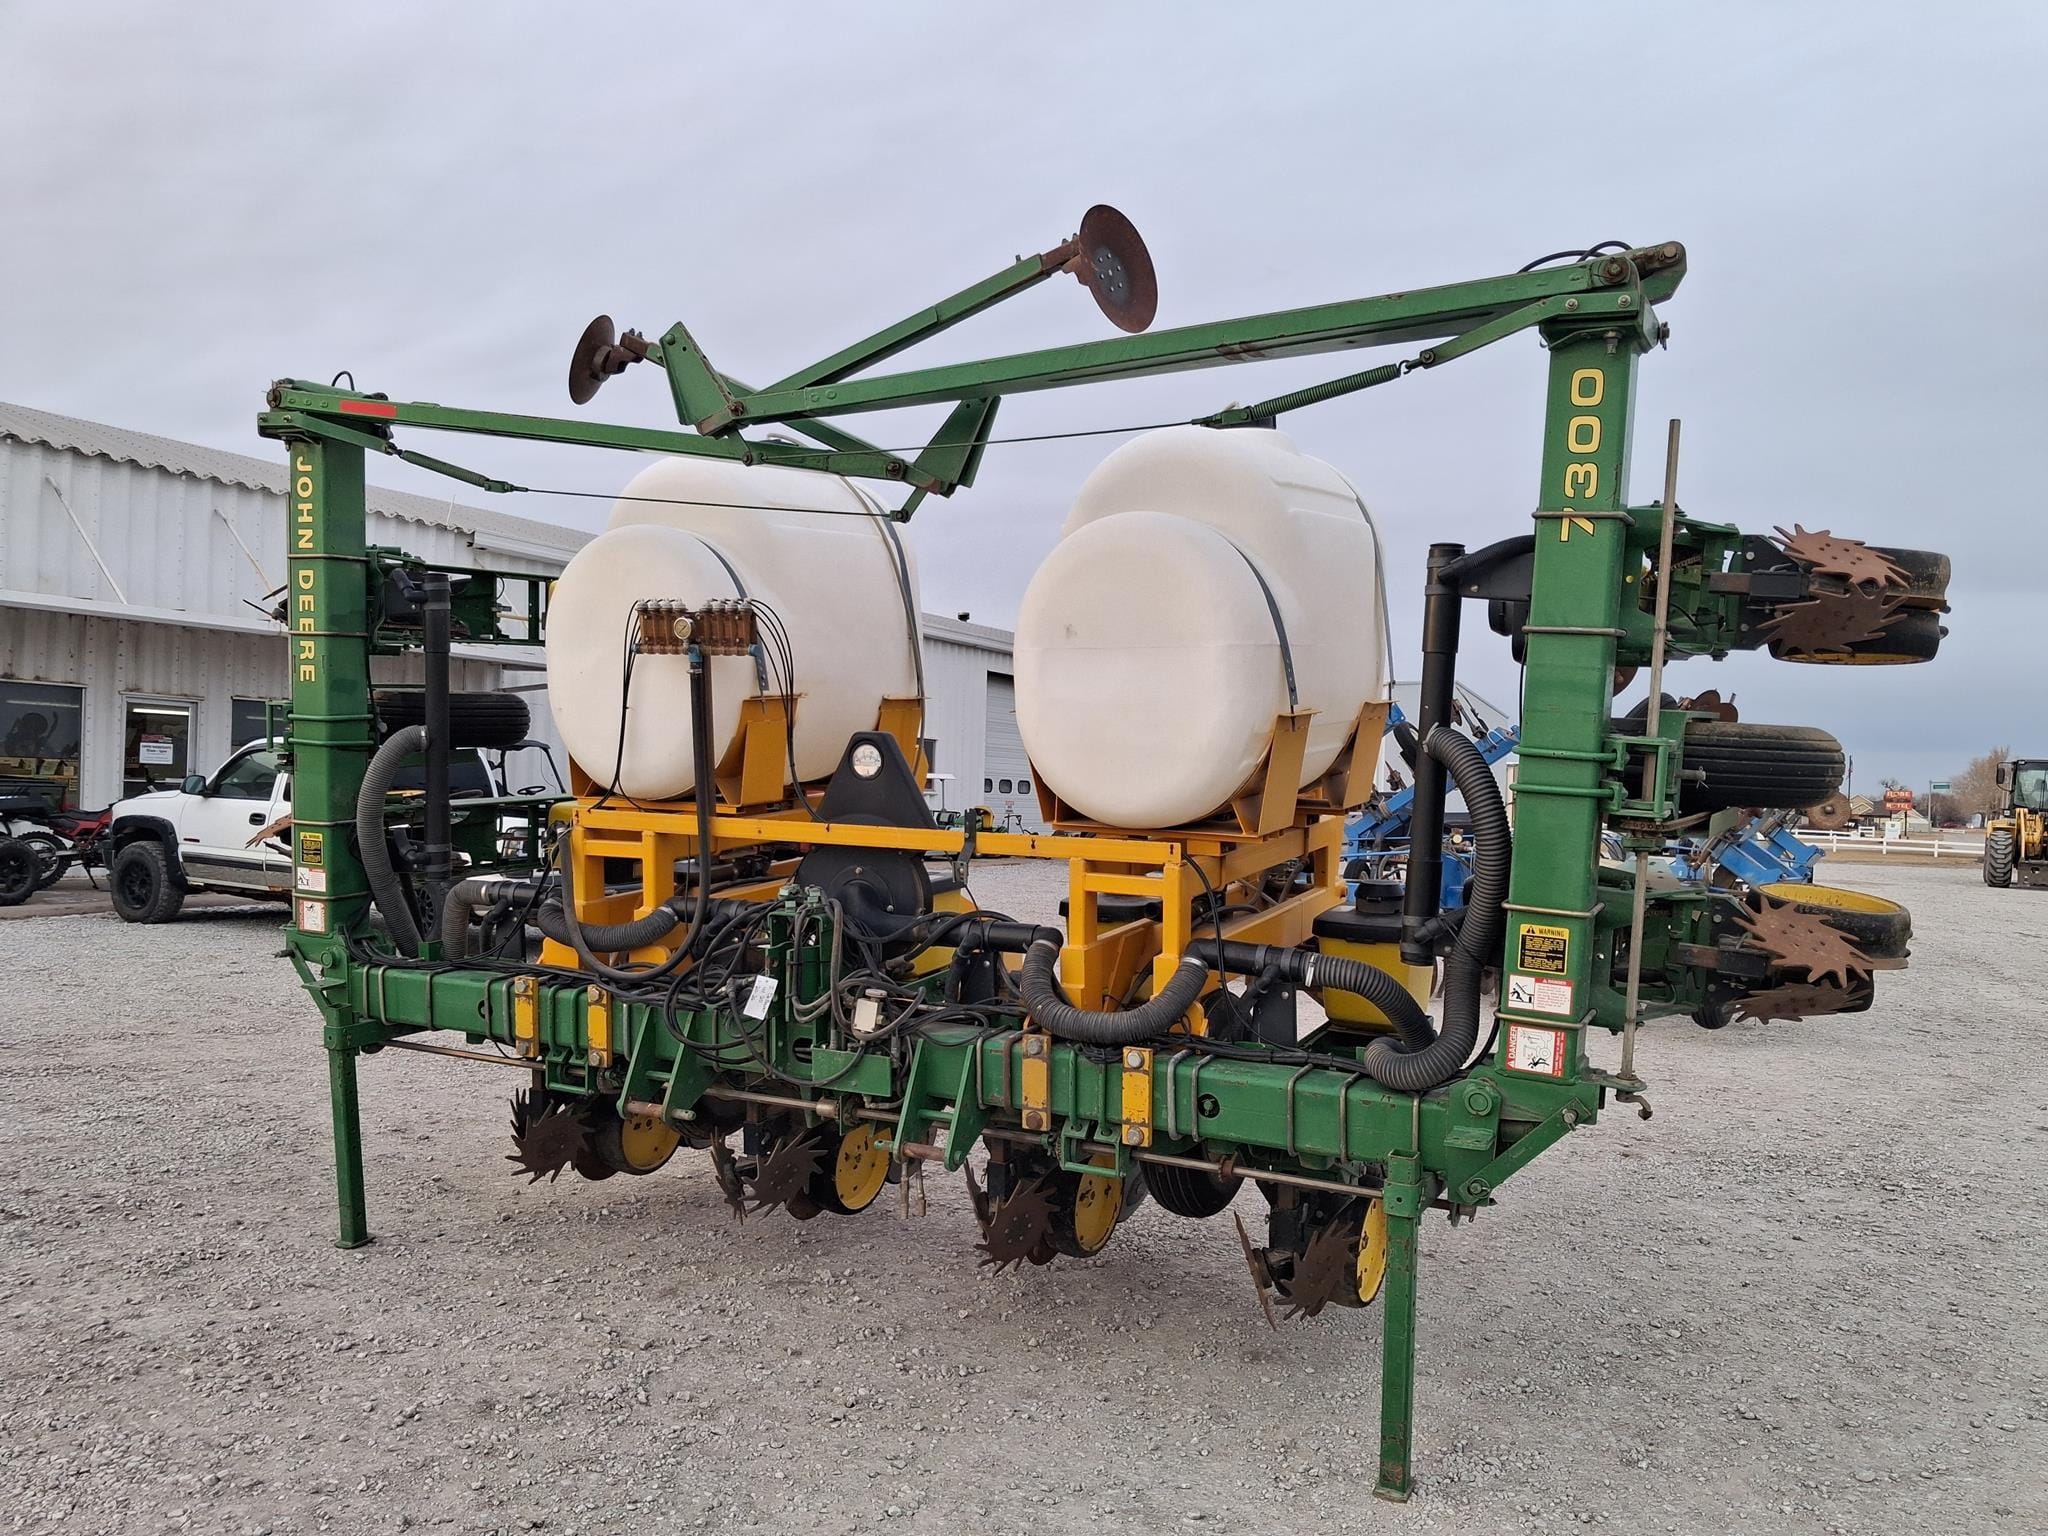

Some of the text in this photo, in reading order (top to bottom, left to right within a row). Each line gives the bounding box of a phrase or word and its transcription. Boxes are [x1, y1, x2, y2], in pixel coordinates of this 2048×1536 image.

[1560, 368, 1605, 542] 7300
[296, 456, 315, 682] JOHN DEERE
[1538, 927, 1565, 938] WARNING
[1508, 1026, 1518, 1059] DANGER
